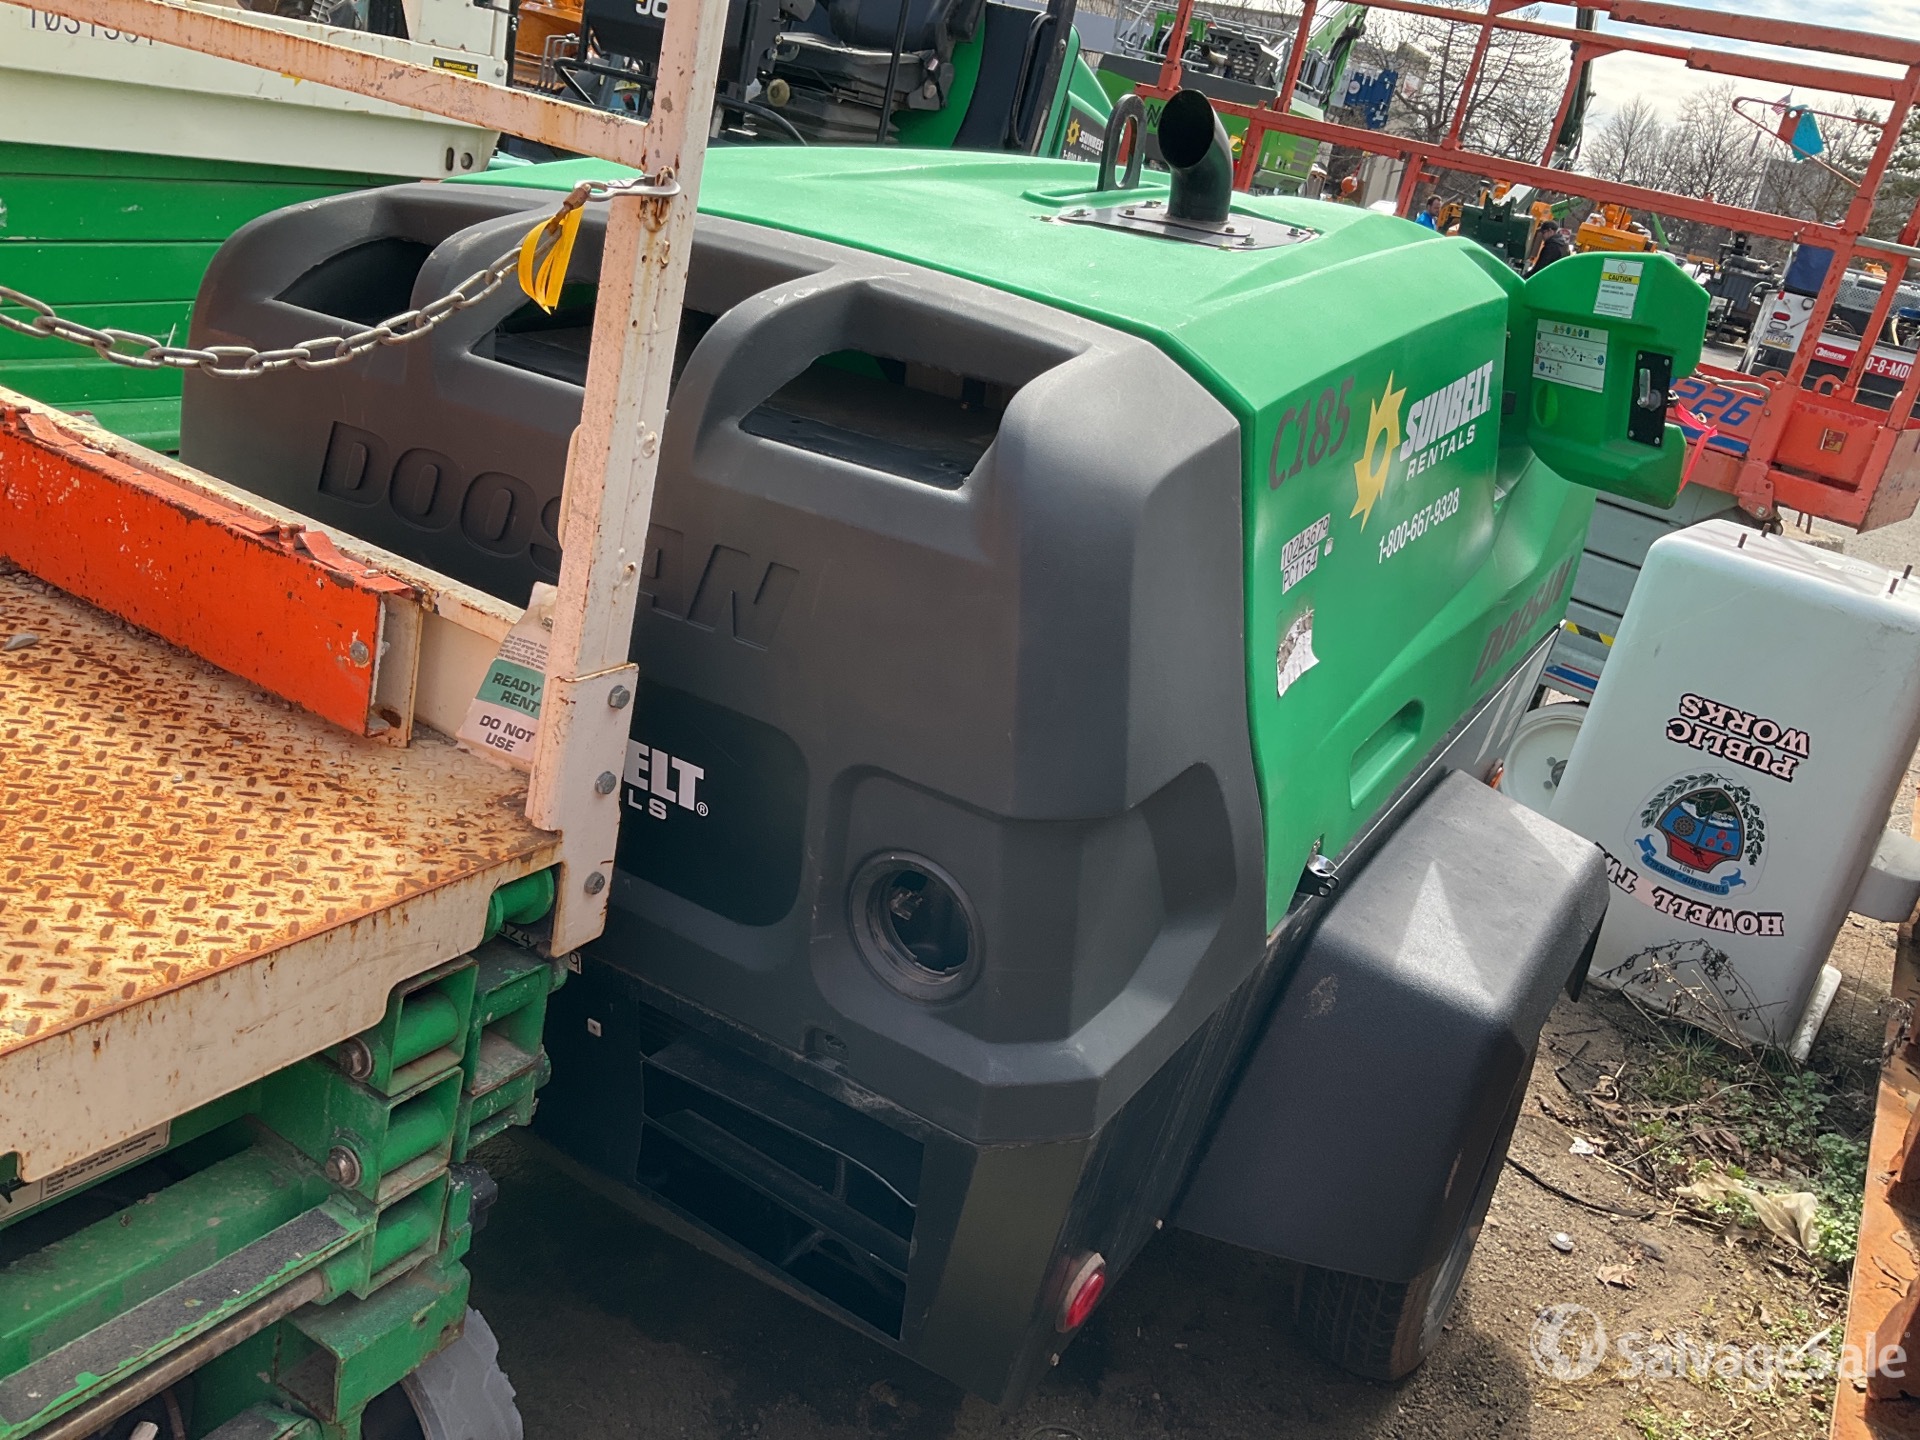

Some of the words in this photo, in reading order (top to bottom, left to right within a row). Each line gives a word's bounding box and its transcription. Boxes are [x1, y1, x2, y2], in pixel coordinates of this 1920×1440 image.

[1608, 273, 1633, 283] CAUTION
[1865, 356, 1913, 379] 0-8-MO
[1400, 360, 1493, 462] SUNBELT
[1671, 378, 1765, 426] 226
[1269, 374, 1355, 491] C185
[1406, 424, 1476, 482] RENTALS
[1282, 516, 1329, 567] 10243679
[1378, 487, 1460, 565] 1-800-667-9328
[1283, 548, 1317, 588] PC1154
[492, 672, 541, 697] READY
[500, 690, 541, 713] RENT
[479, 714, 502, 730] DO
[503, 722, 536, 743] NOT
[485, 732, 516, 752] USE
[1666, 716, 1800, 783] PUBLIC
[1678, 692, 1810, 759] WORKS
[624, 738, 704, 812] ELT
[628, 788, 667, 820] LS
[1593, 842, 1639, 894] TW
[1651, 886, 1785, 937] HOWELL
